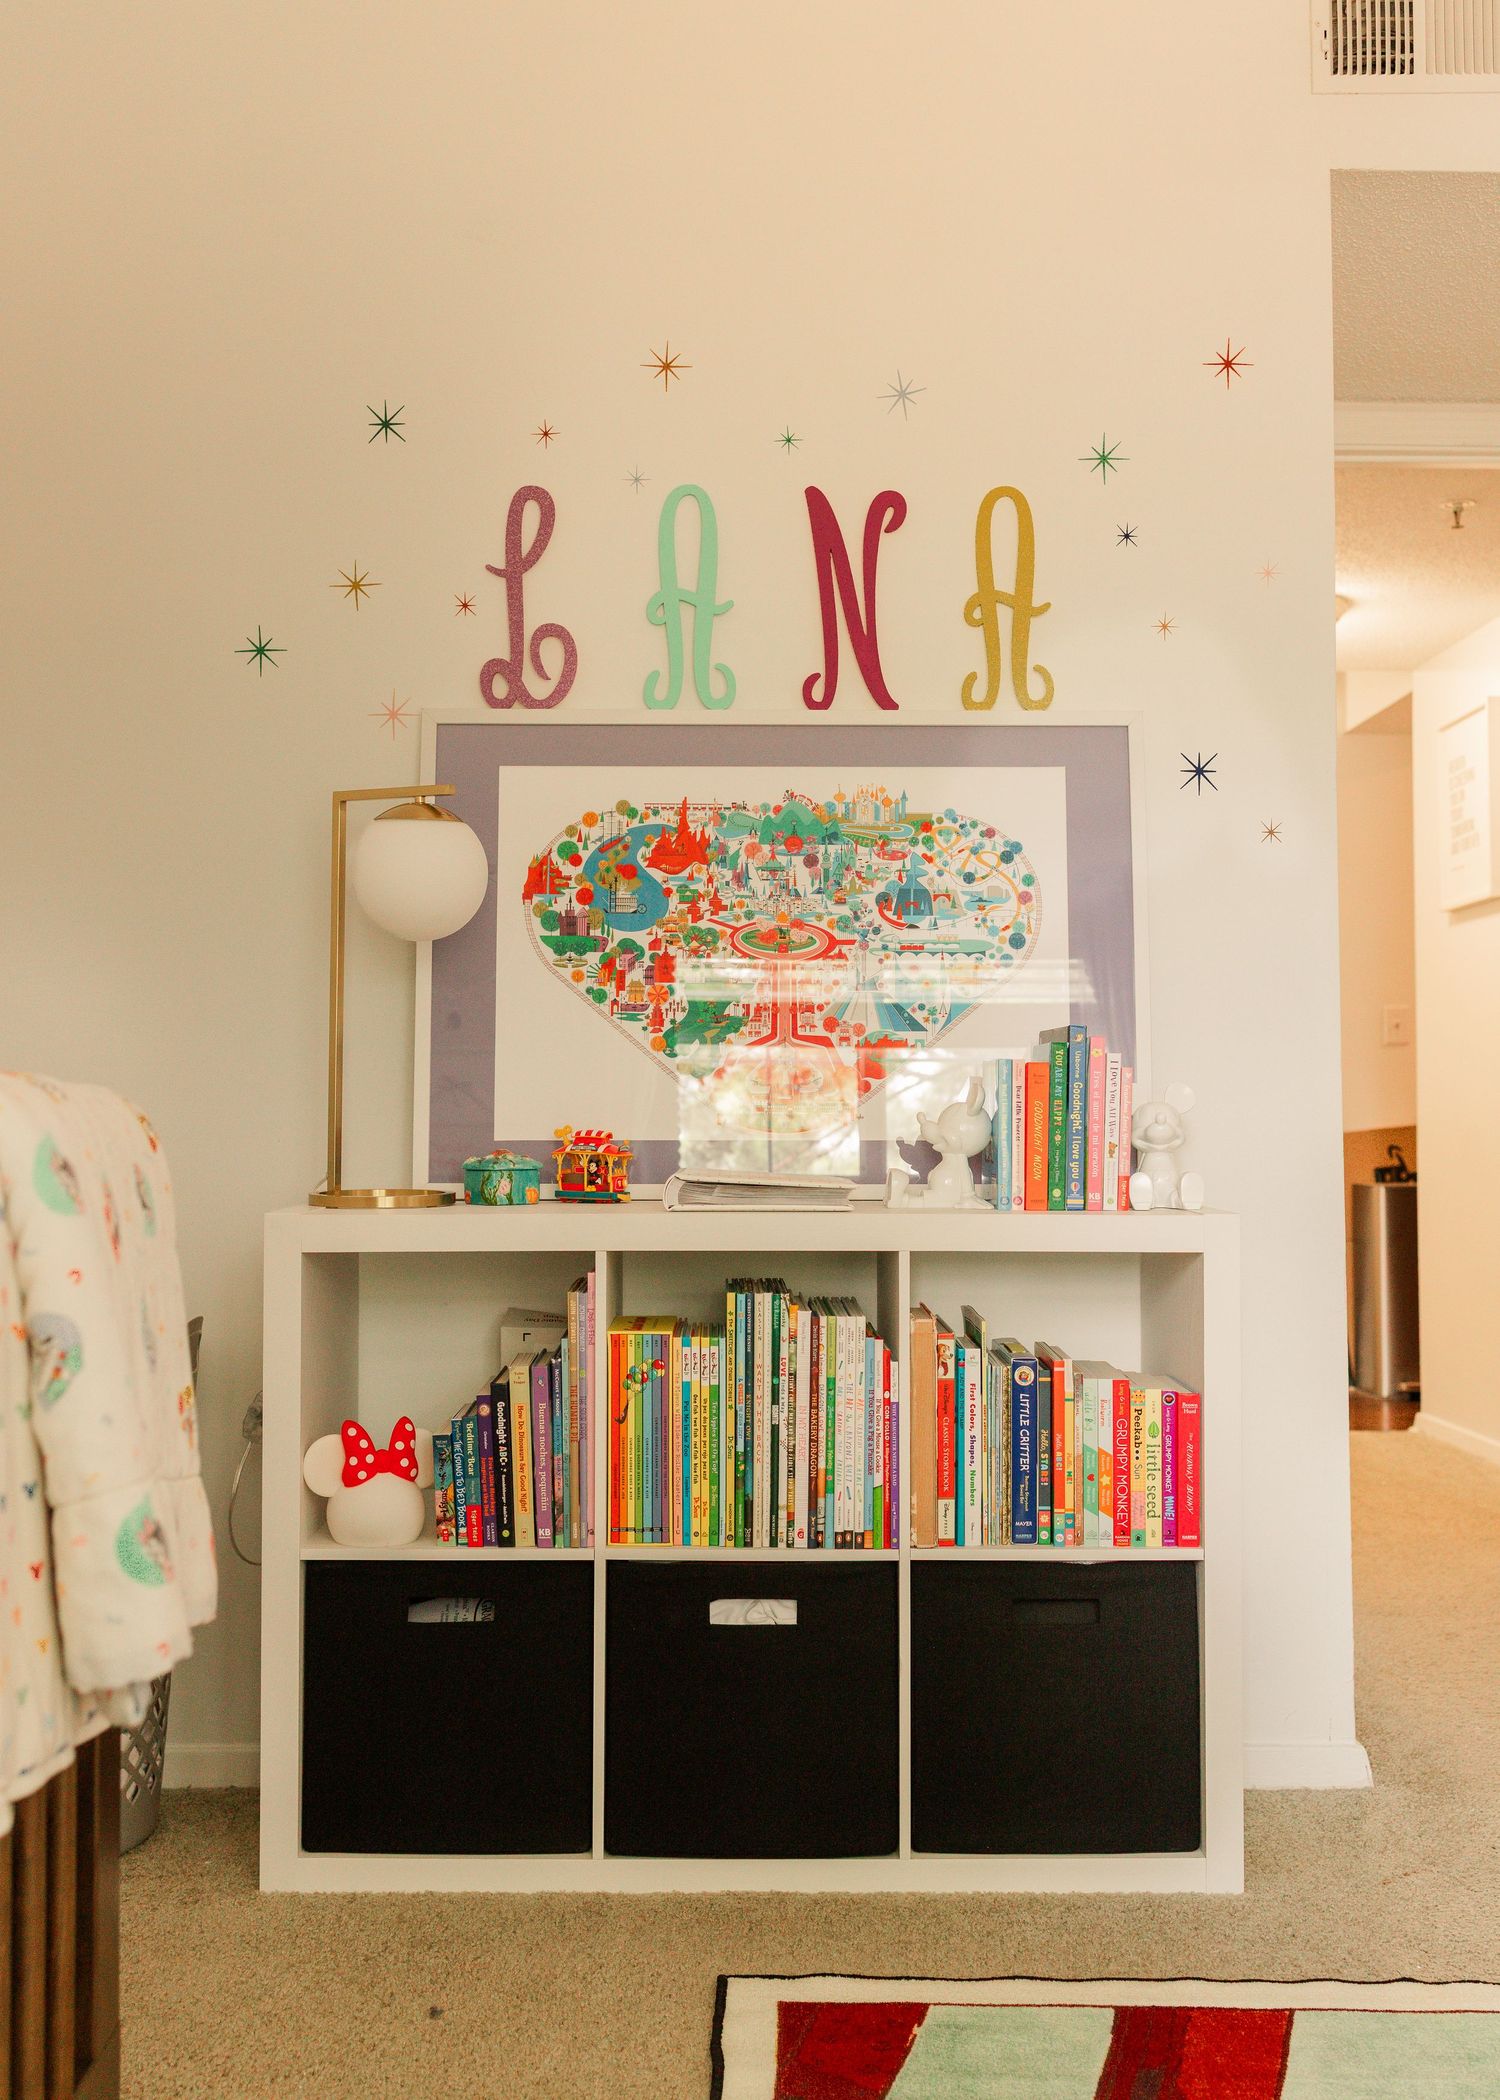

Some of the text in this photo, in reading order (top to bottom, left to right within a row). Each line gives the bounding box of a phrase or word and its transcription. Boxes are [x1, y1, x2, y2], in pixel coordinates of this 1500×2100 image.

[1093, 1071, 1101, 1088] Eres
[1110, 1067, 1119, 1087] Love
[1054, 1049, 1063, 1126] YOU ARE MY HAPPY
[1093, 1123, 1100, 1133] de
[1033, 1100, 1043, 1181] GOODNIGHT MOON
[1073, 1141, 1081, 1159] love
[1093, 1135, 1100, 1145] mi
[1070, 1162, 1079, 1178] you
[757, 1395, 762, 1407] MY
[496, 1402, 507, 1444] Goodnight
[519, 1421, 525, 1431] Do
[684, 1414, 689, 1424] Me
[810, 1408, 818, 1441] BAKERY
[466, 1422, 476, 1455] Bedtime
[799, 1405, 807, 1463] IN MY HEART
[1019, 1393, 1030, 1471] LITTLE CRITTER
[711, 1439, 718, 1448] Up
[712, 1449, 717, 1458] On
[969, 1435, 977, 1467] Shapes,
[454, 1453, 465, 1476] GOING
[468, 1456, 476, 1475] Bear
[538, 1402, 549, 1511] Buenas noches, pequeñín
[1039, 1429, 1049, 1486] Hello, STARS!
[518, 1463, 526, 1473] Say
[1116, 1418, 1129, 1528] GRUMPY MONKEY
[1134, 1464, 1142, 1480] Sun
[483, 1484, 488, 1492] on
[1147, 1444, 1161, 1519] little seed
[457, 1487, 466, 1504] BED
[519, 1493, 527, 1512] Night?
[1185, 1484, 1194, 1514] BUNNY
[458, 1506, 467, 1527] BOOK
[1164, 1496, 1175, 1520] MINE!
